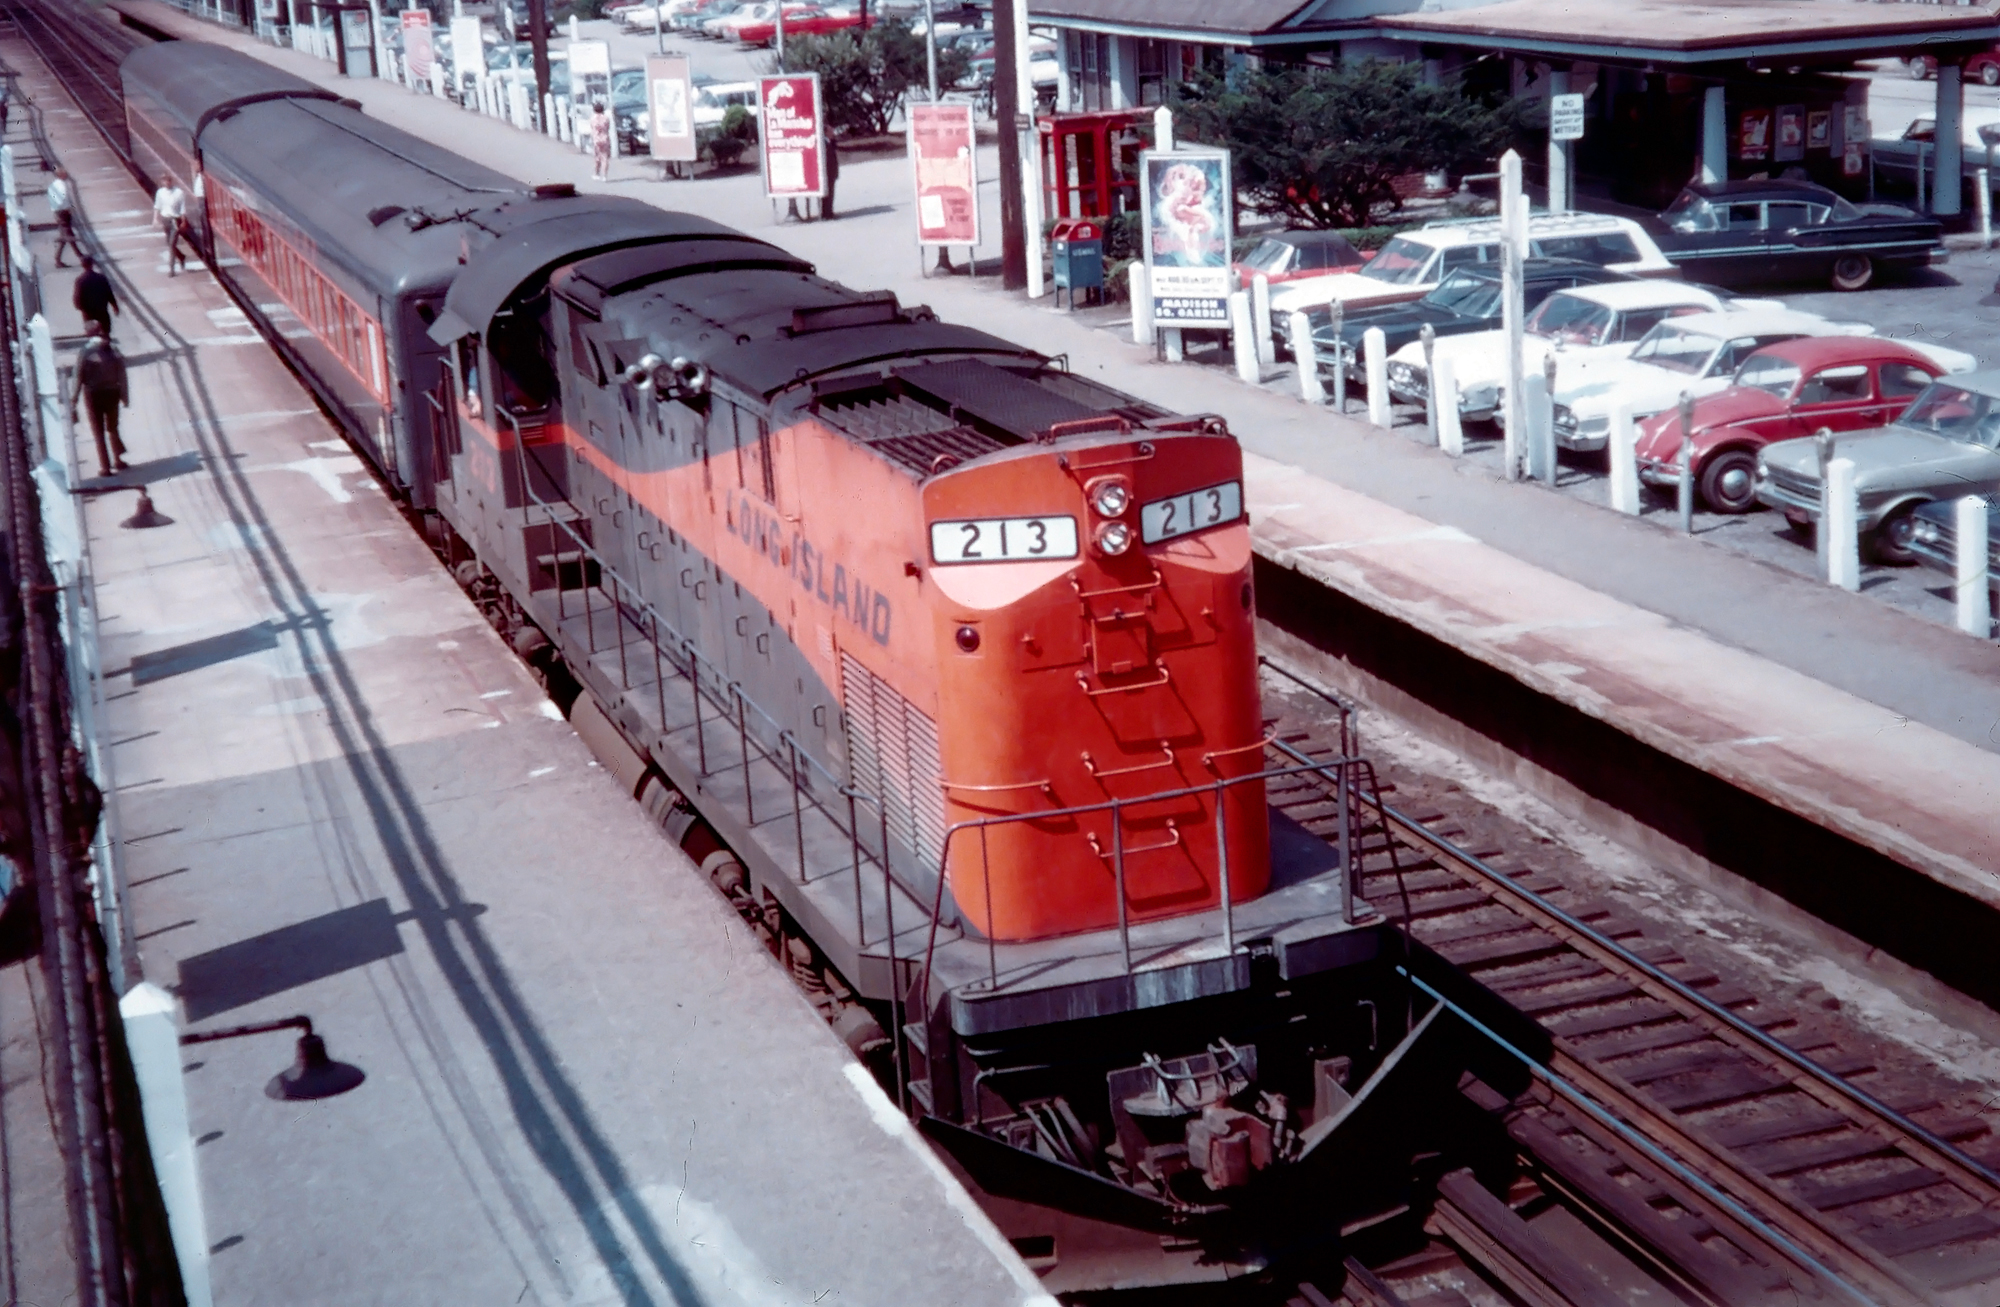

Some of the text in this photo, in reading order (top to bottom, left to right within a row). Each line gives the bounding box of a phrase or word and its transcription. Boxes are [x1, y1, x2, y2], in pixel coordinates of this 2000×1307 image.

[1155, 307, 1225, 318] SQ. GARDEN
[1161, 298, 1218, 308] MADISON
[1160, 490, 1222, 536] 213
[960, 520, 1049, 558] 213
[725, 489, 892, 647] LONG ISLAND
